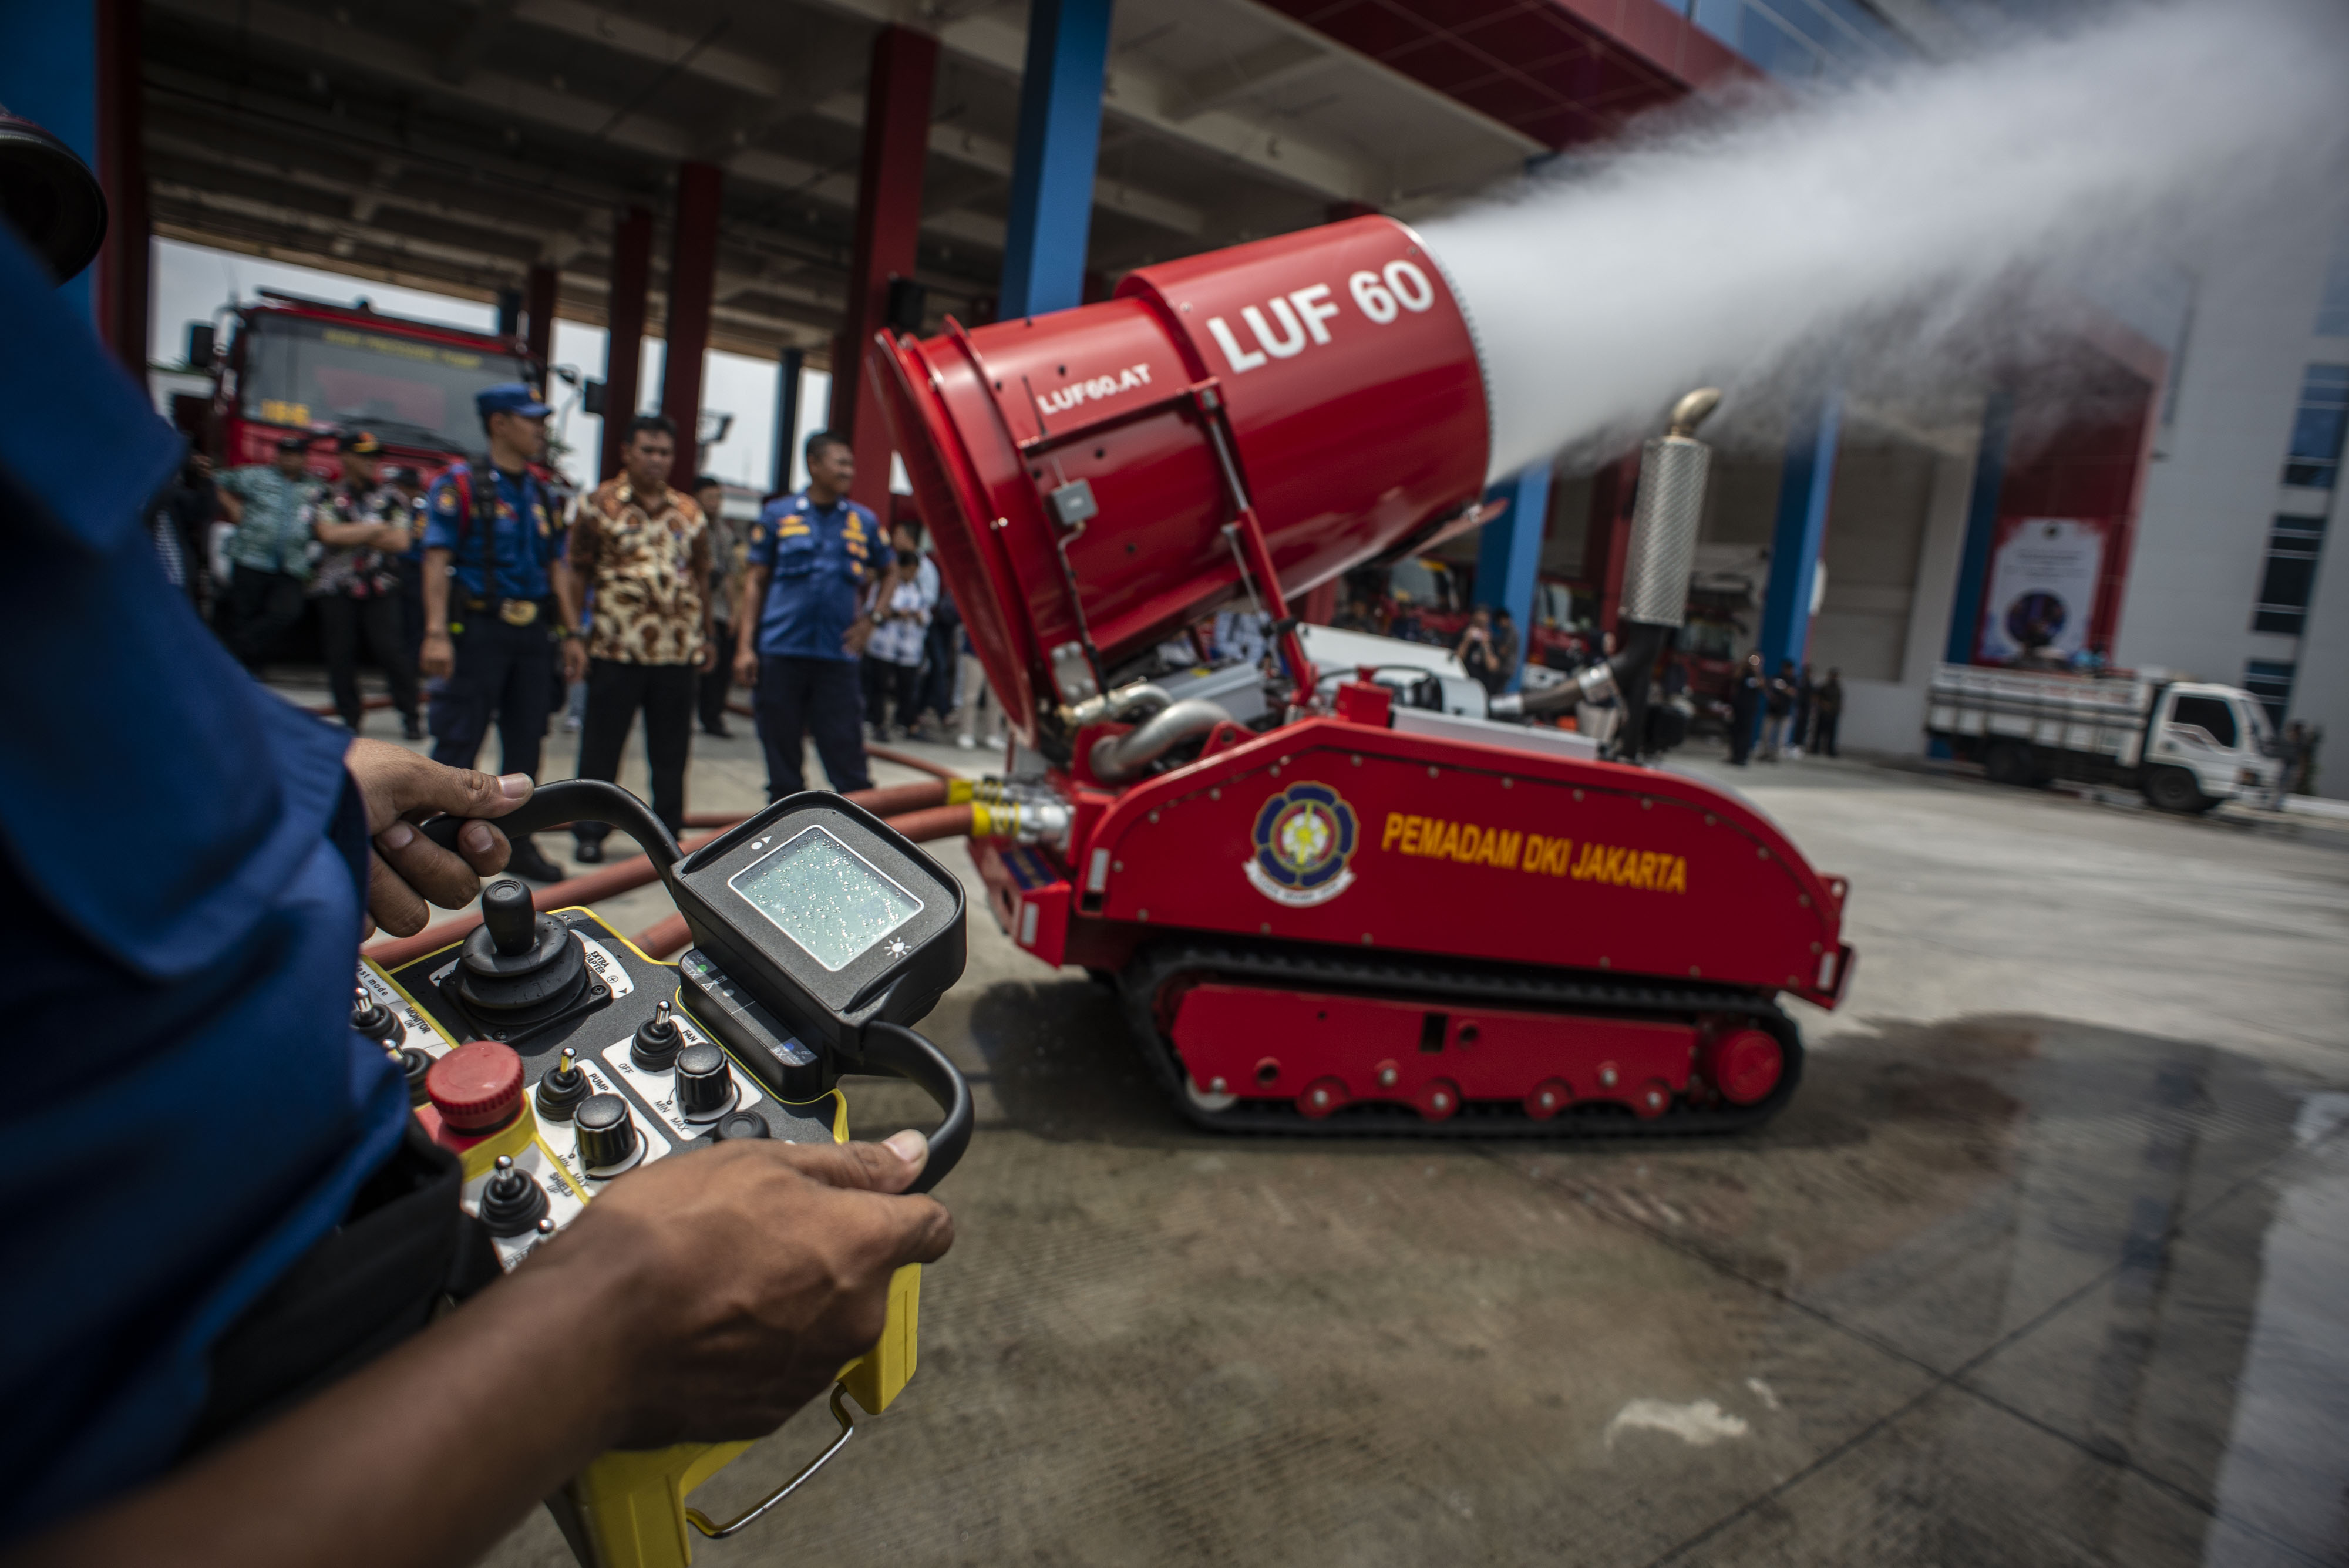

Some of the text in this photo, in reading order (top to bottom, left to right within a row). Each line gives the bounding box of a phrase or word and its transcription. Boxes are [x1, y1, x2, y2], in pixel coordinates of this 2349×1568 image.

[1206, 259, 1435, 374] LUF 60
[1036, 363, 1152, 415] LUF60.AT
[1381, 811, 1687, 894] PEMADAM DKI JAKARTA
[590, 951, 610, 968] EXTRA
[688, 968, 699, 978] TX
[368, 978, 388, 996] mode
[404, 1019, 416, 1028] ON
[405, 1007, 432, 1034] MONITOR
[682, 1029, 698, 1042] FAN
[772, 1048, 786, 1058] RX
[618, 1063, 634, 1073] OFF
[588, 1072, 609, 1091] PUMP
[654, 1101, 671, 1112] MIN
[670, 1117, 689, 1132] MAX
[558, 1155, 571, 1167] MIN
[550, 1172, 573, 1197] SHIELD
[573, 1173, 590, 1187] MAX
[547, 1184, 560, 1193] UP
